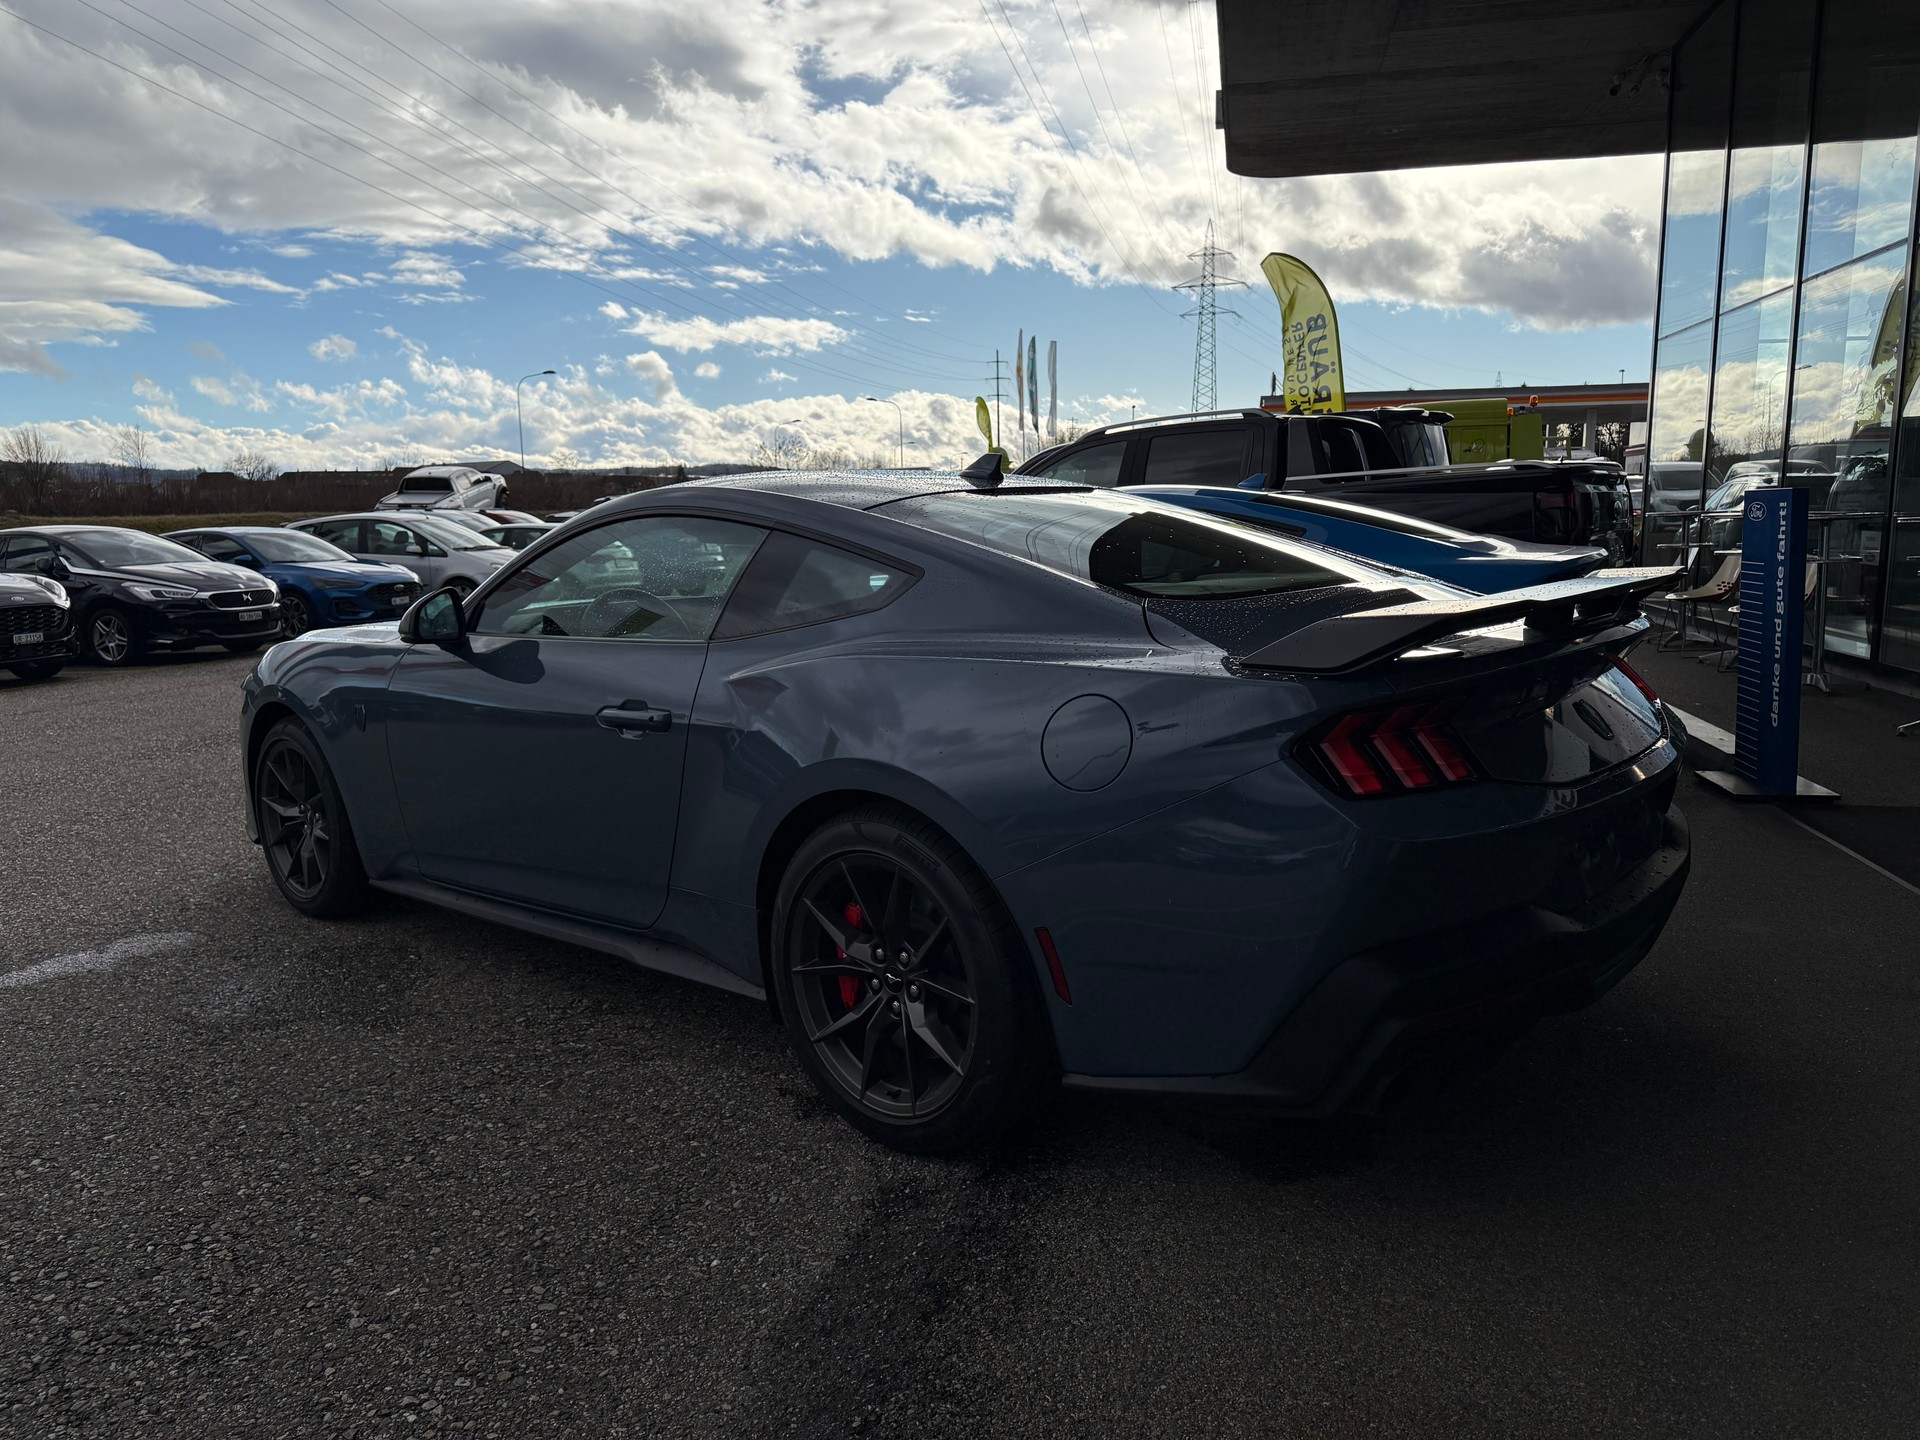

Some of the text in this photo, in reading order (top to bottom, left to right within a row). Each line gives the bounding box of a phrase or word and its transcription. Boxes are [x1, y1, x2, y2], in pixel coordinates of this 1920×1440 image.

[1770, 501, 1788, 728] danke und gute fahrt!
